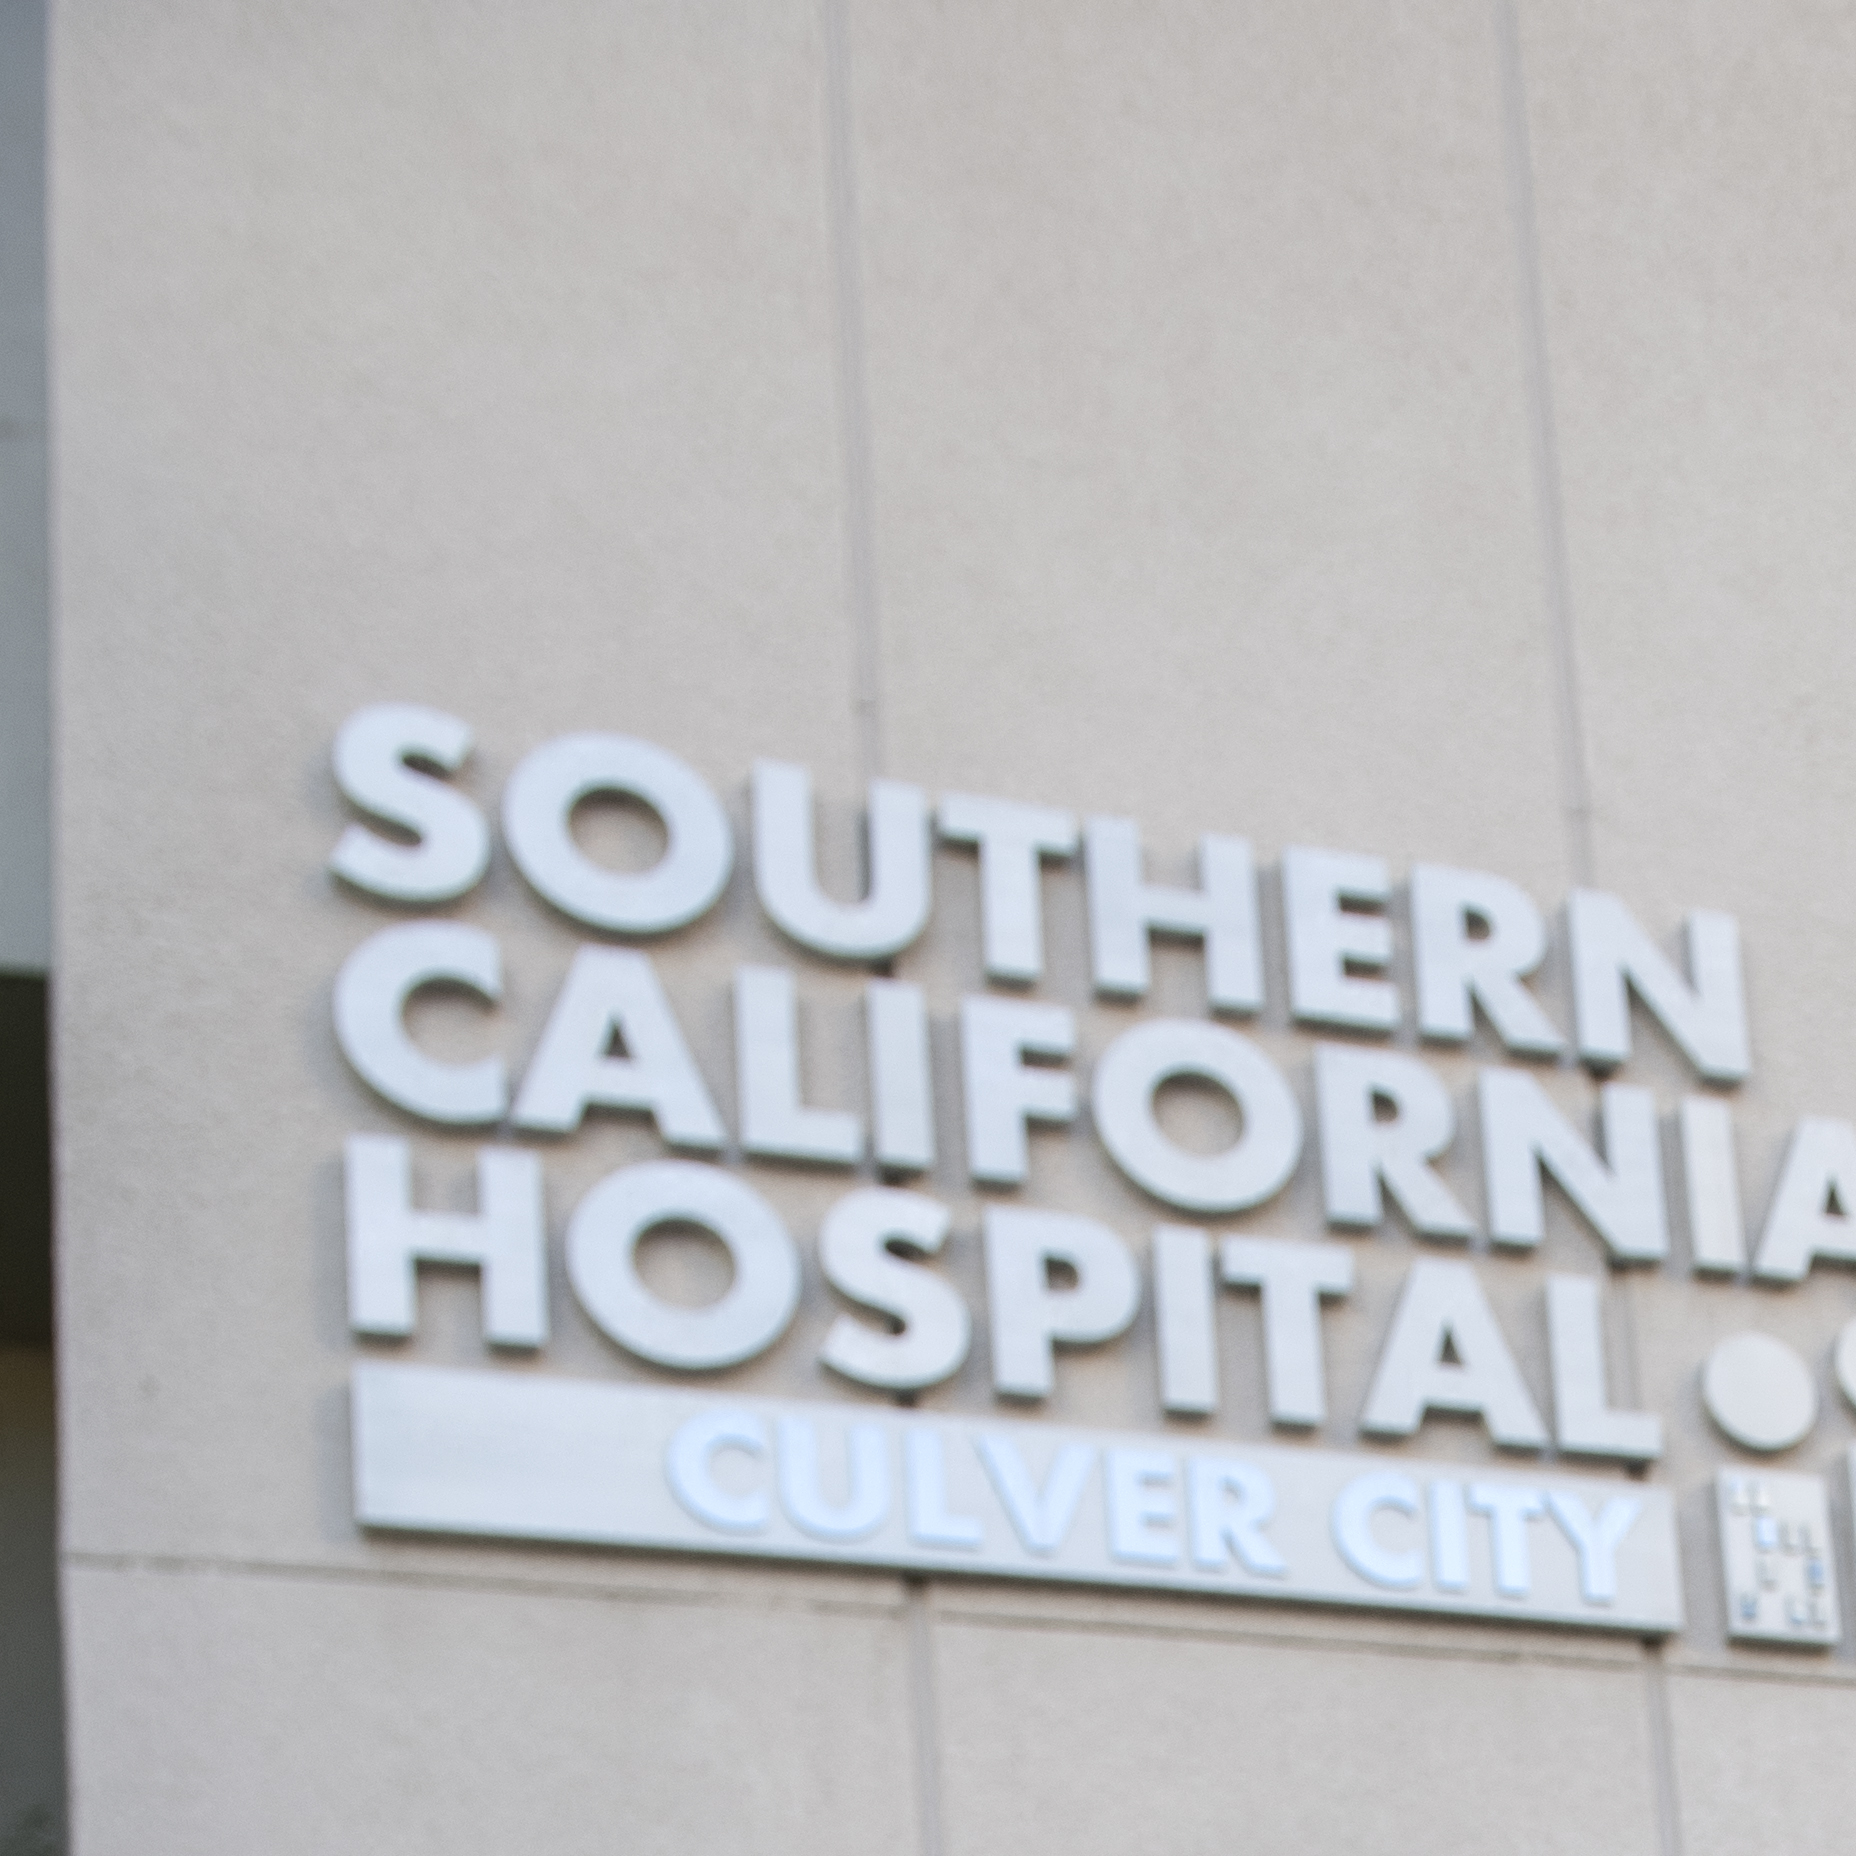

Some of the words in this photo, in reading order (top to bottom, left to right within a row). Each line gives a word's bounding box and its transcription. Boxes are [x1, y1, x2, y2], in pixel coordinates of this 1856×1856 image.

[330, 703, 1751, 1087] SOUTHERN
[346, 1133, 1663, 1460] HOSPITAL
[667, 1408, 1288, 1576] CULVER
[1331, 1470, 1643, 1604] CITY
